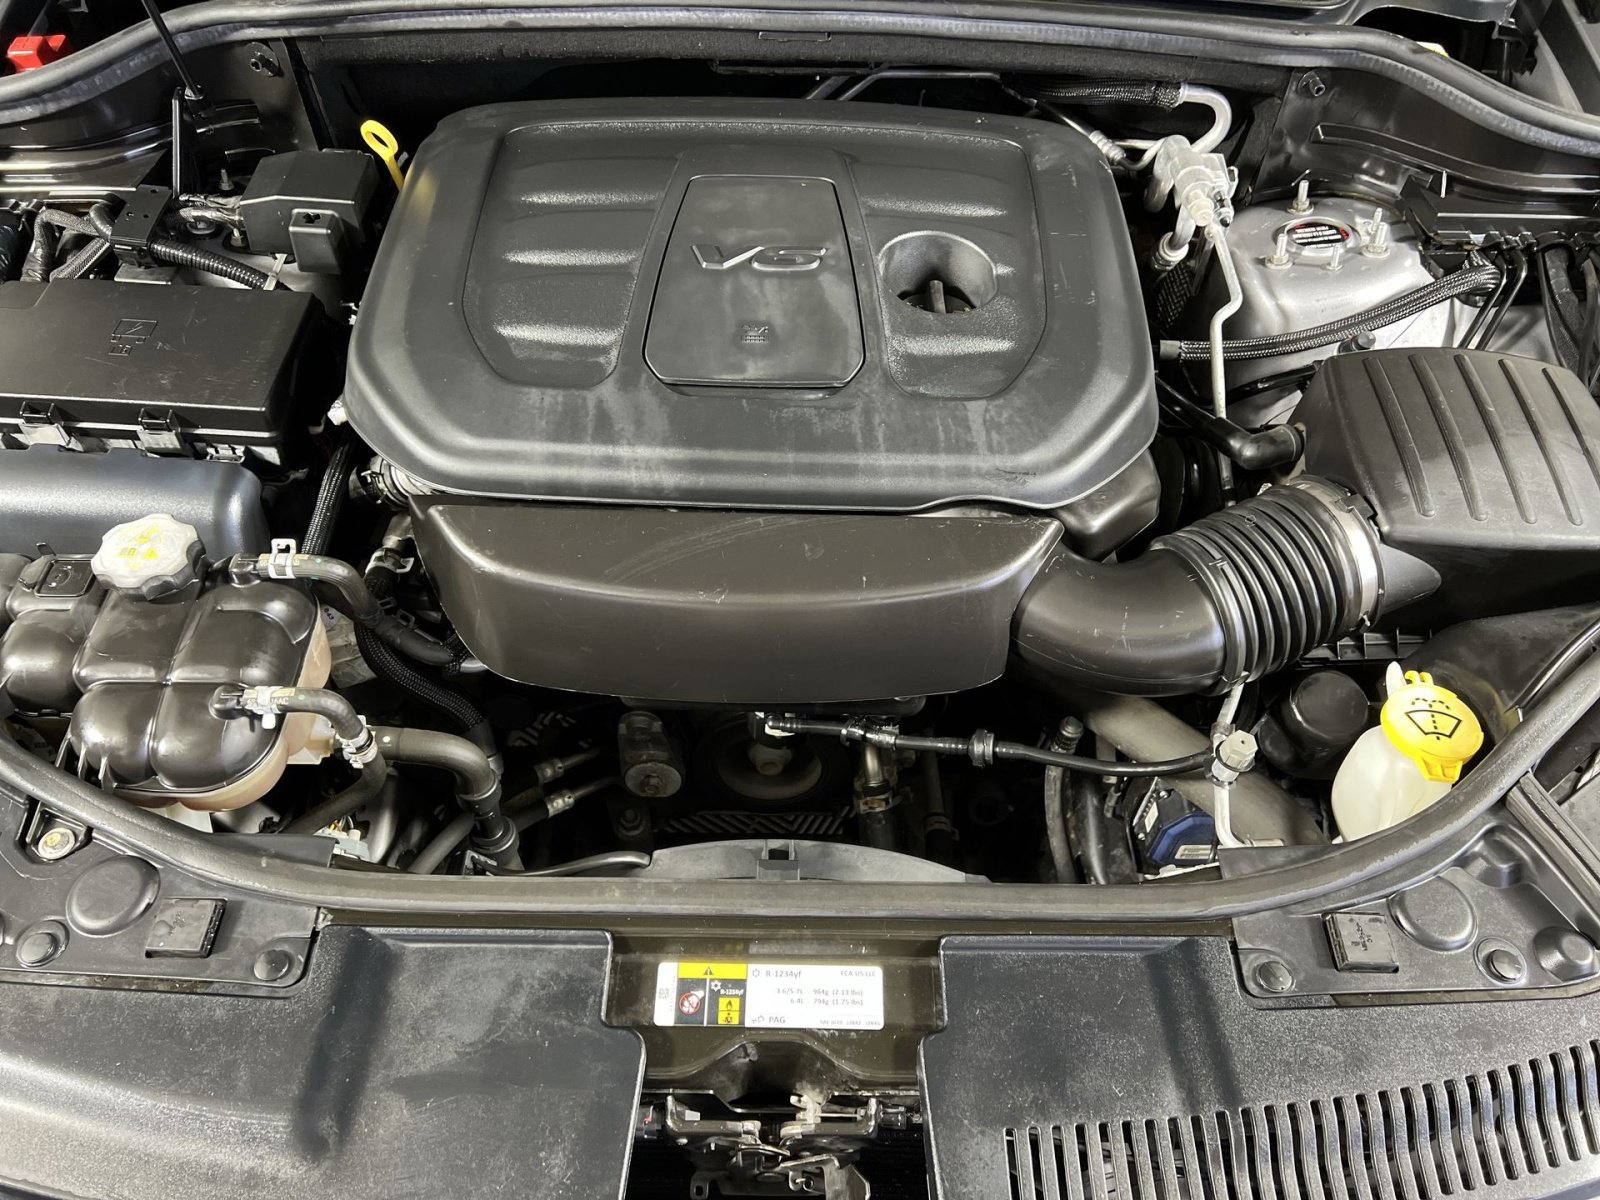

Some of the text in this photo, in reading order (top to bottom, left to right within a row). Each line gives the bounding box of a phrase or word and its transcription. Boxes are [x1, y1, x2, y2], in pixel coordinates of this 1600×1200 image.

[690, 245, 828, 272] V6
[766, 970, 802, 979] R-1234yf
[768, 1016, 786, 1024] PAG
